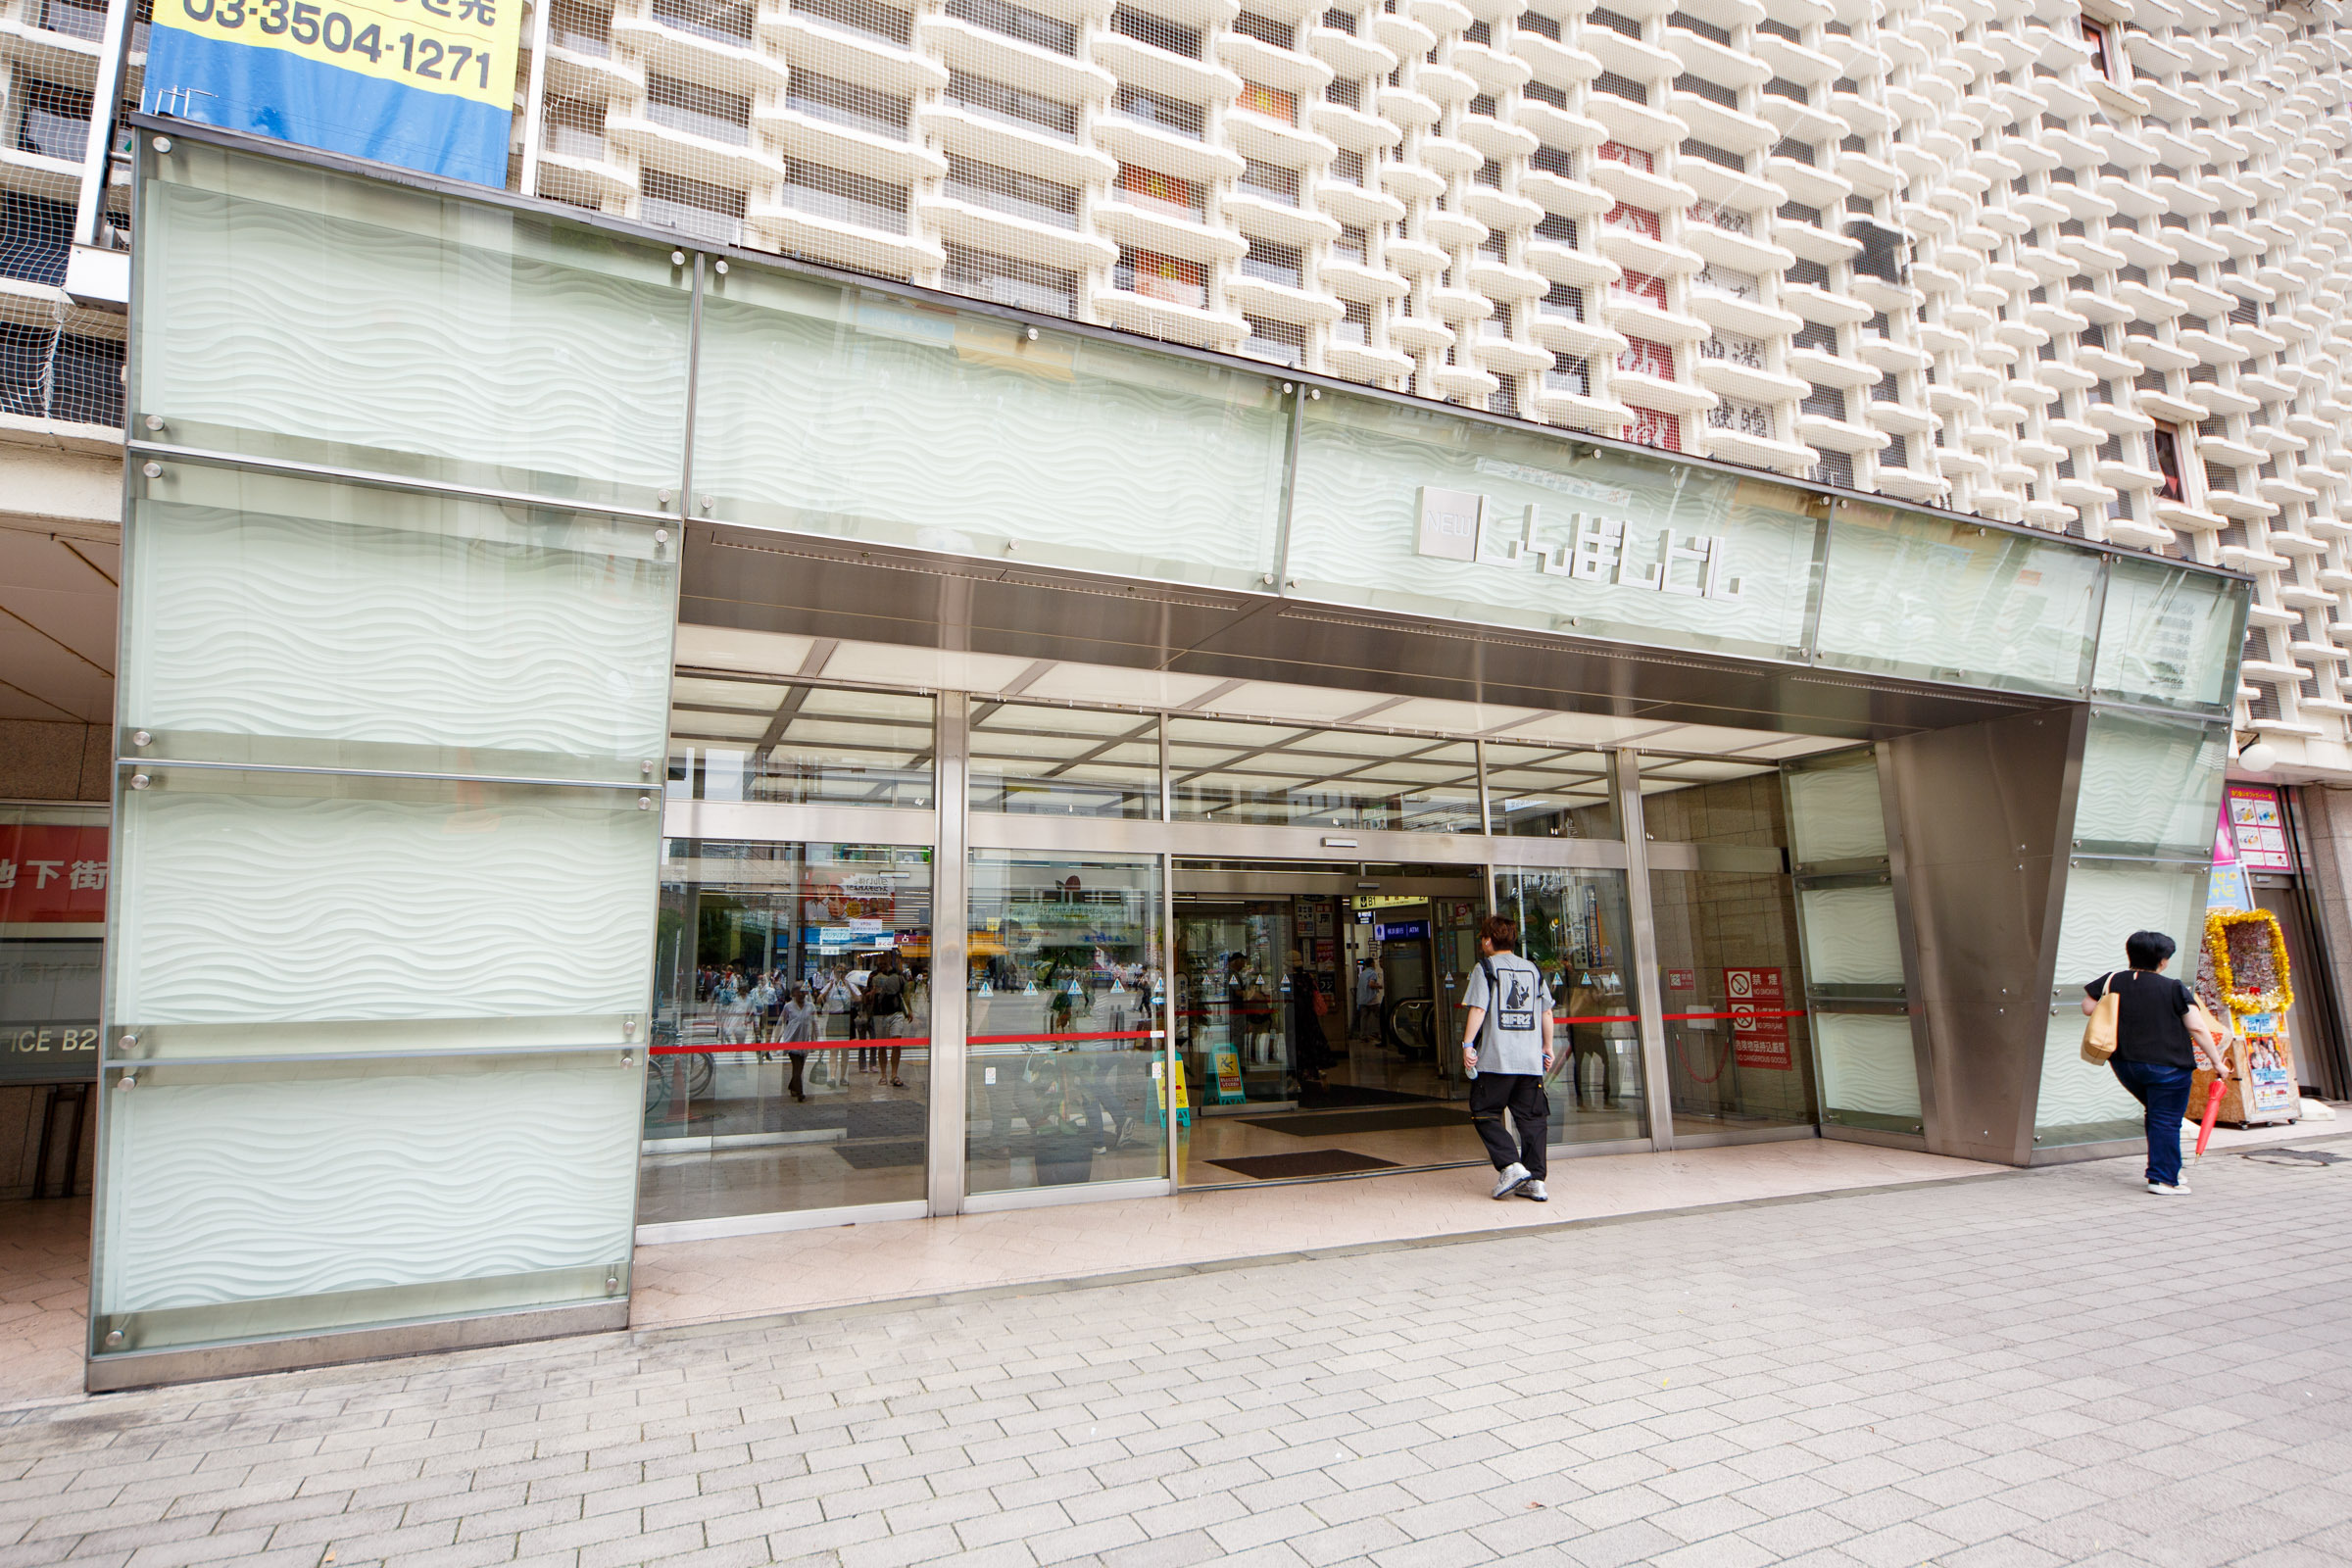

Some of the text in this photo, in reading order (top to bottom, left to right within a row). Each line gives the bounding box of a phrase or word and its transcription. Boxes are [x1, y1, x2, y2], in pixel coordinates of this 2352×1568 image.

[183, 0, 491, 89] 03-3504-1271
[1425, 510, 1473, 537] NEW
[1752, 973, 1778, 986] 禁煙
[62, 1029, 98, 1052] B2
